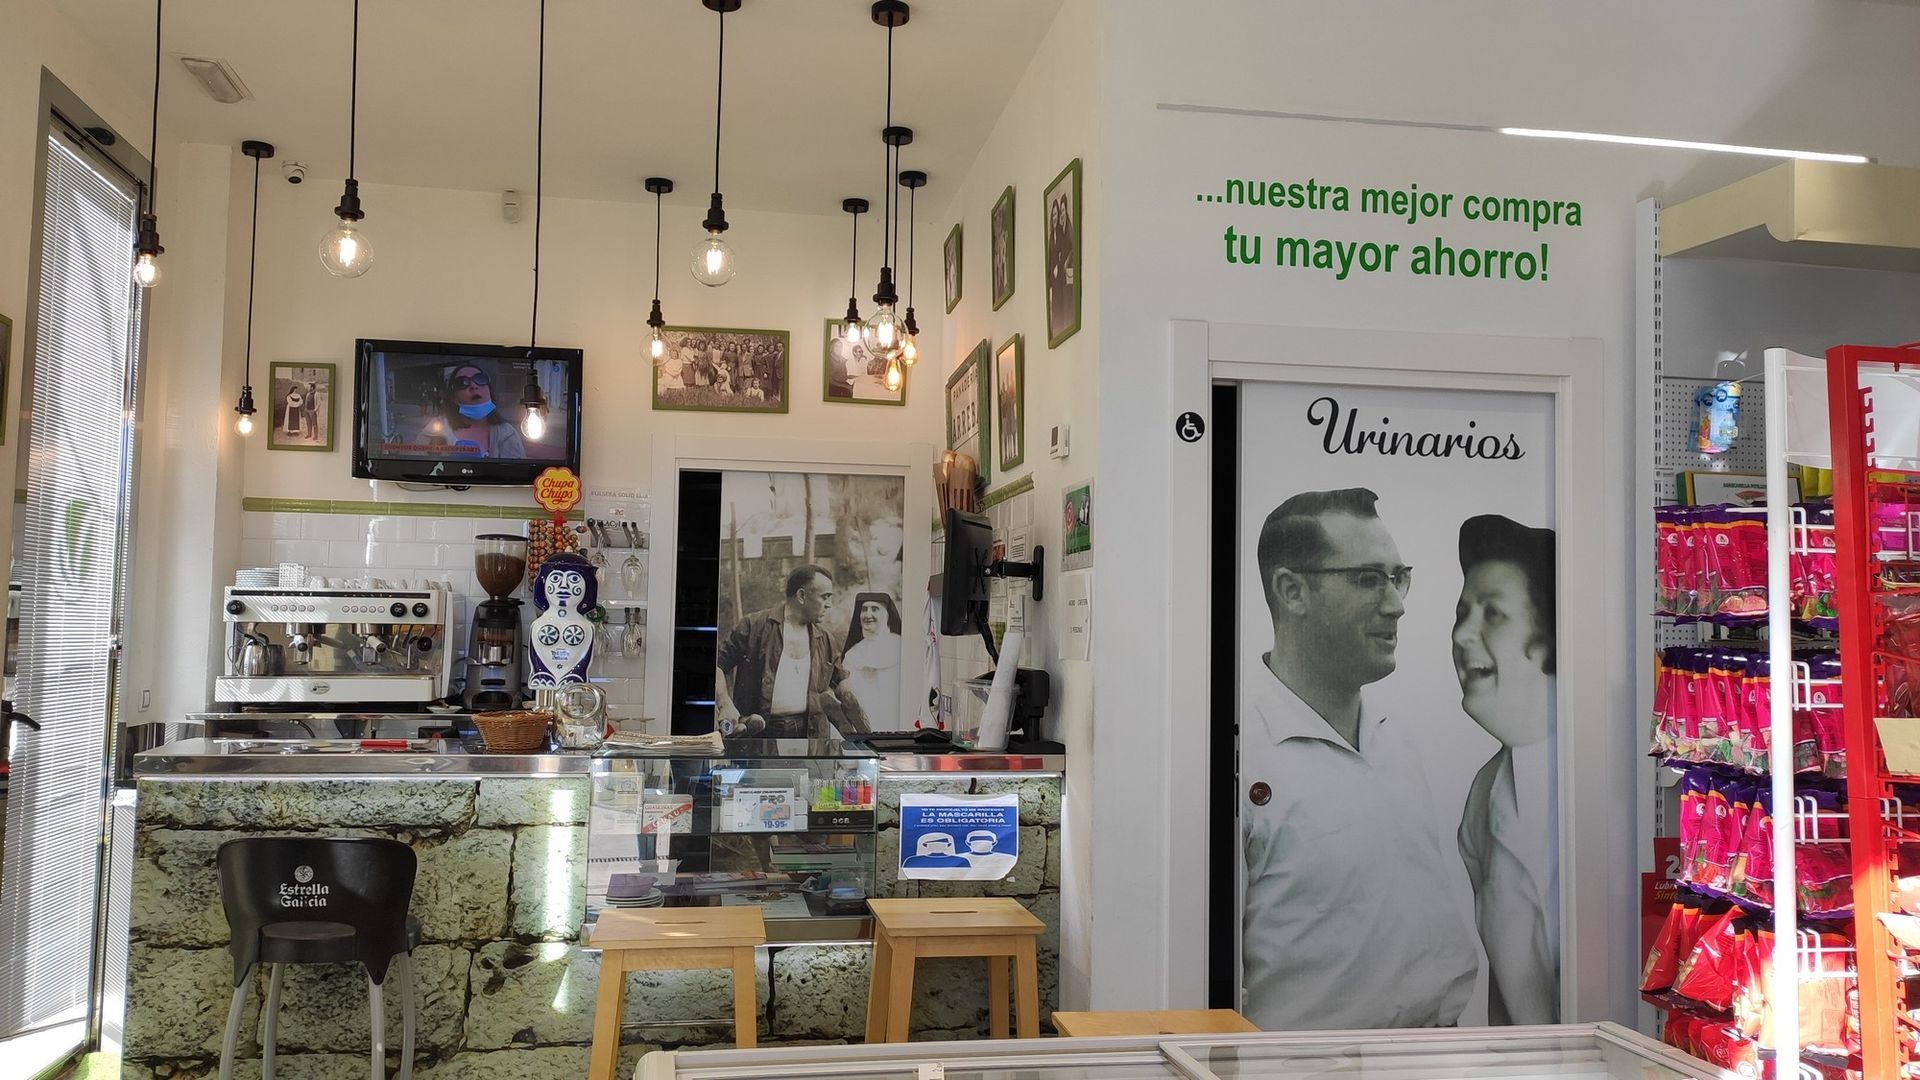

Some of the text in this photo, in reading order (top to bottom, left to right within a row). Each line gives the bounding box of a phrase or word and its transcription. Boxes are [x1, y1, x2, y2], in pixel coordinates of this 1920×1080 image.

[1197, 177, 1582, 232] ...nuestra mejor compra
[1224, 225, 1549, 281] tu mayor ahorro!
[952, 401, 978, 444] ARREB
[1307, 397, 1526, 460] Urinarios
[540, 488, 574, 504] Chups
[542, 478, 575, 489] Chupa
[759, 795, 785, 804] PRO
[278, 883, 330, 896] Estrella
